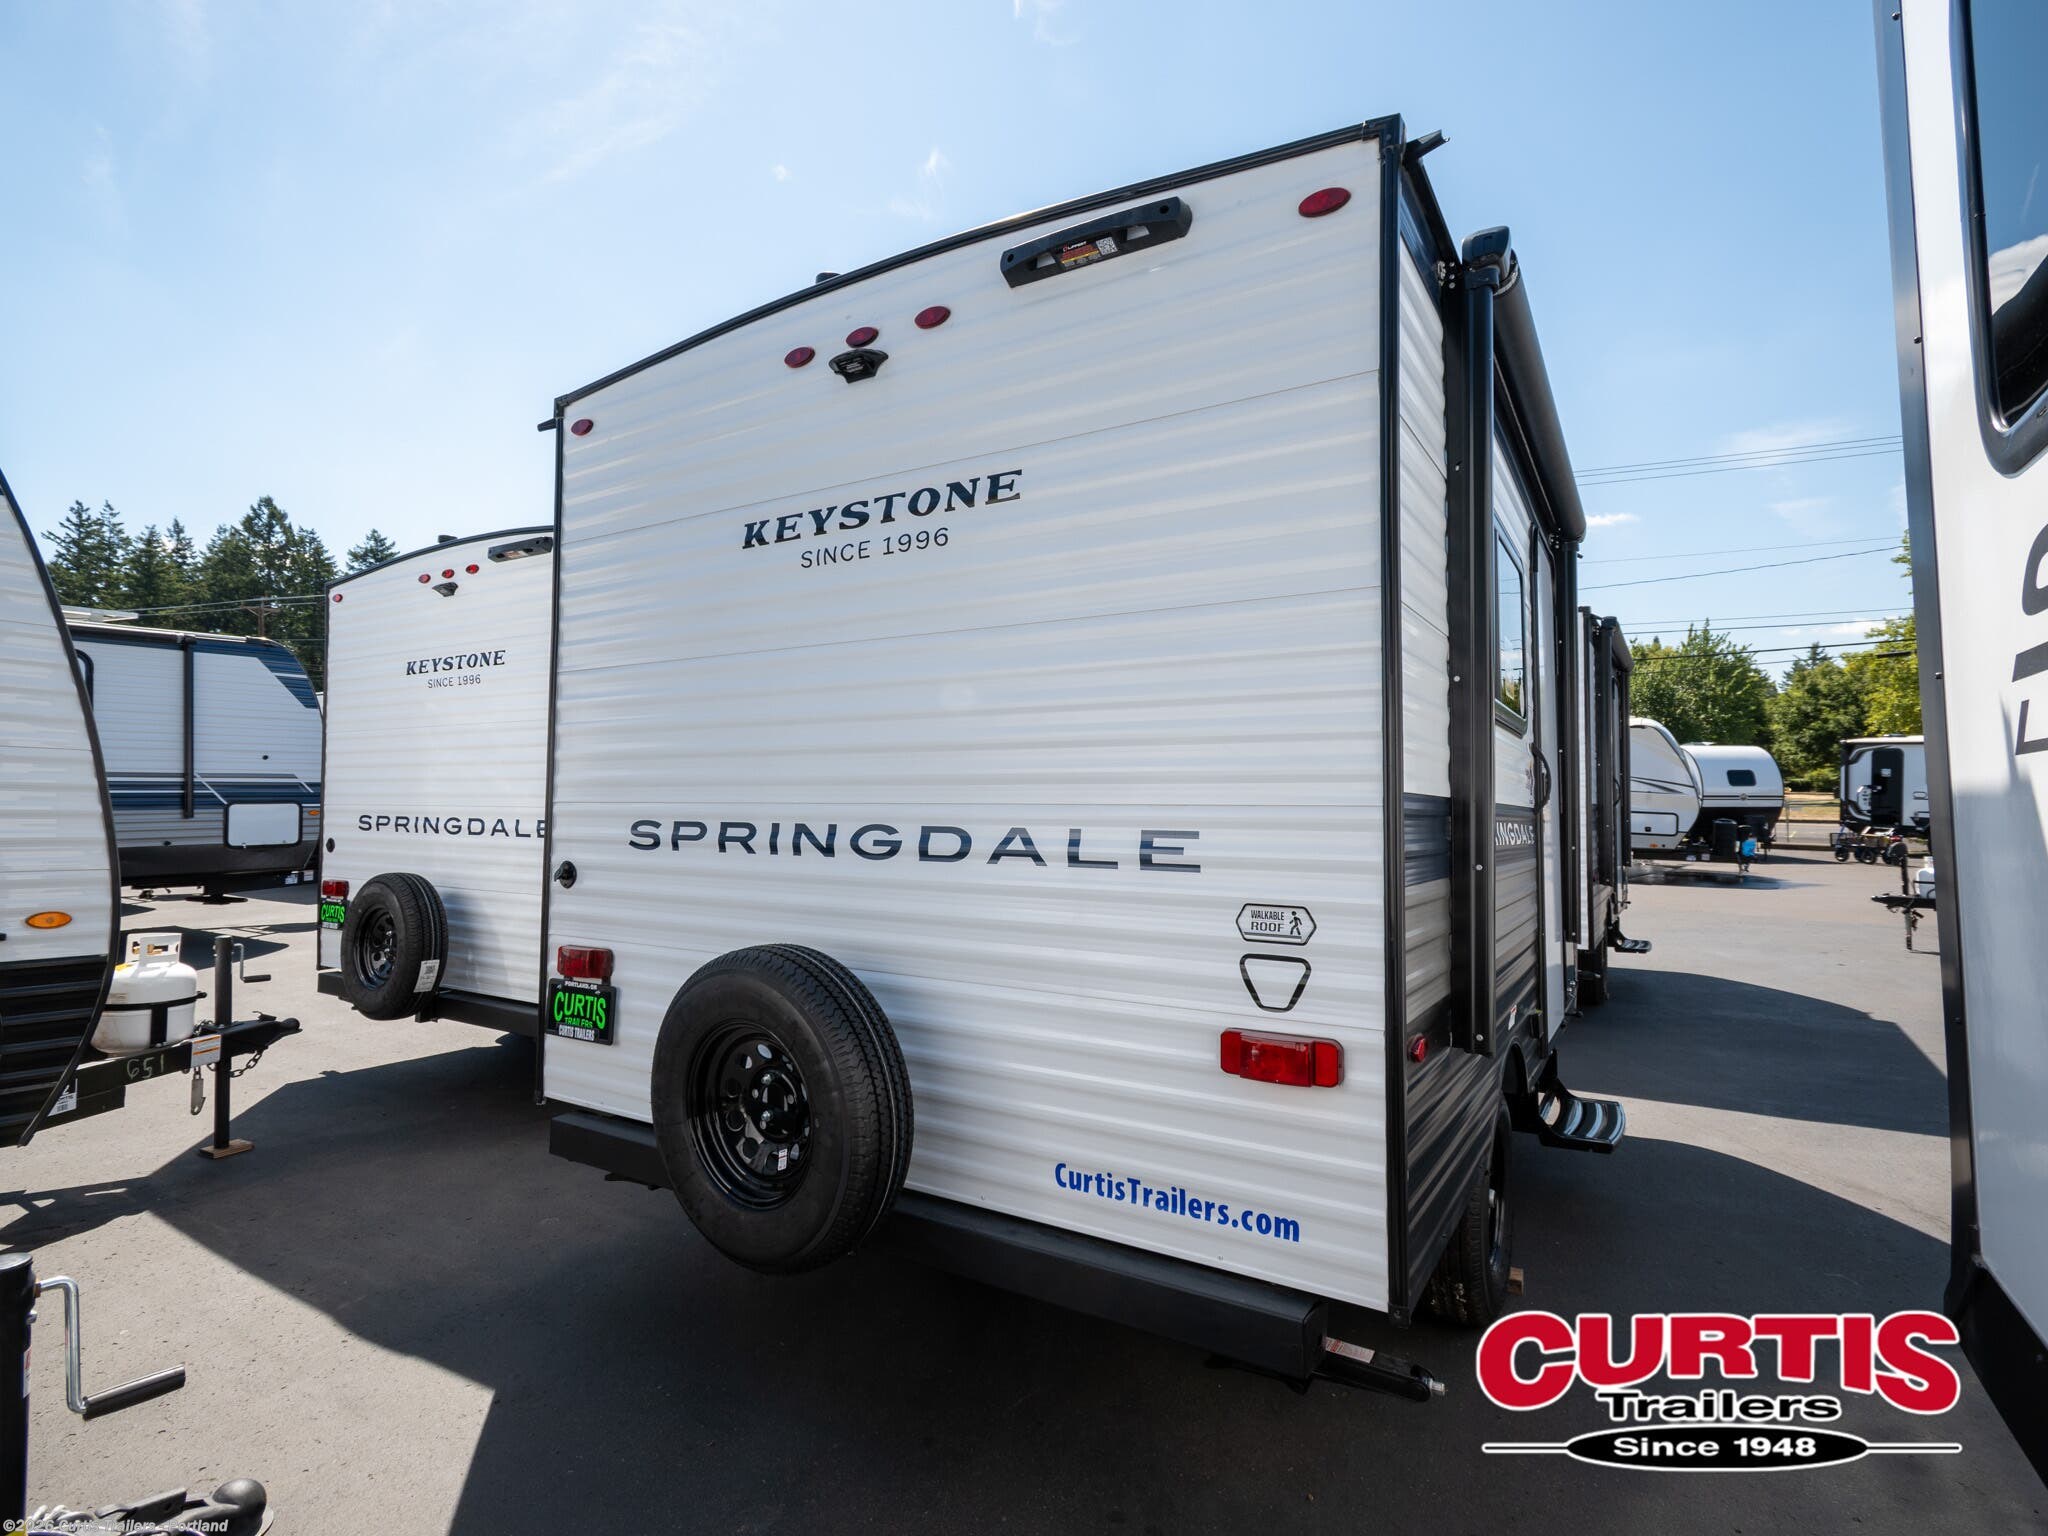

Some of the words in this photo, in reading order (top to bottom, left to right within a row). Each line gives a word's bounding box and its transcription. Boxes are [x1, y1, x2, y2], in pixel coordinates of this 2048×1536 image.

[742, 469, 1023, 549] KEYSTONE
[801, 540, 871, 568] SINCE
[882, 527, 949, 555] 1996
[406, 650, 506, 675] KEYSTONE
[427, 677, 454, 688] SINCE
[458, 674, 481, 686] 1996
[628, 819, 1201, 874] SPRINGDALE
[321, 904, 345, 923] CURTIS
[1250, 910, 1285, 921] WALKABLE
[1251, 921, 1285, 932] ROOF
[554, 991, 606, 1029] CURTIS
[574, 1026, 595, 1041] TRAILERS
[1055, 1163, 1300, 1242] CurtisTrailers.com
